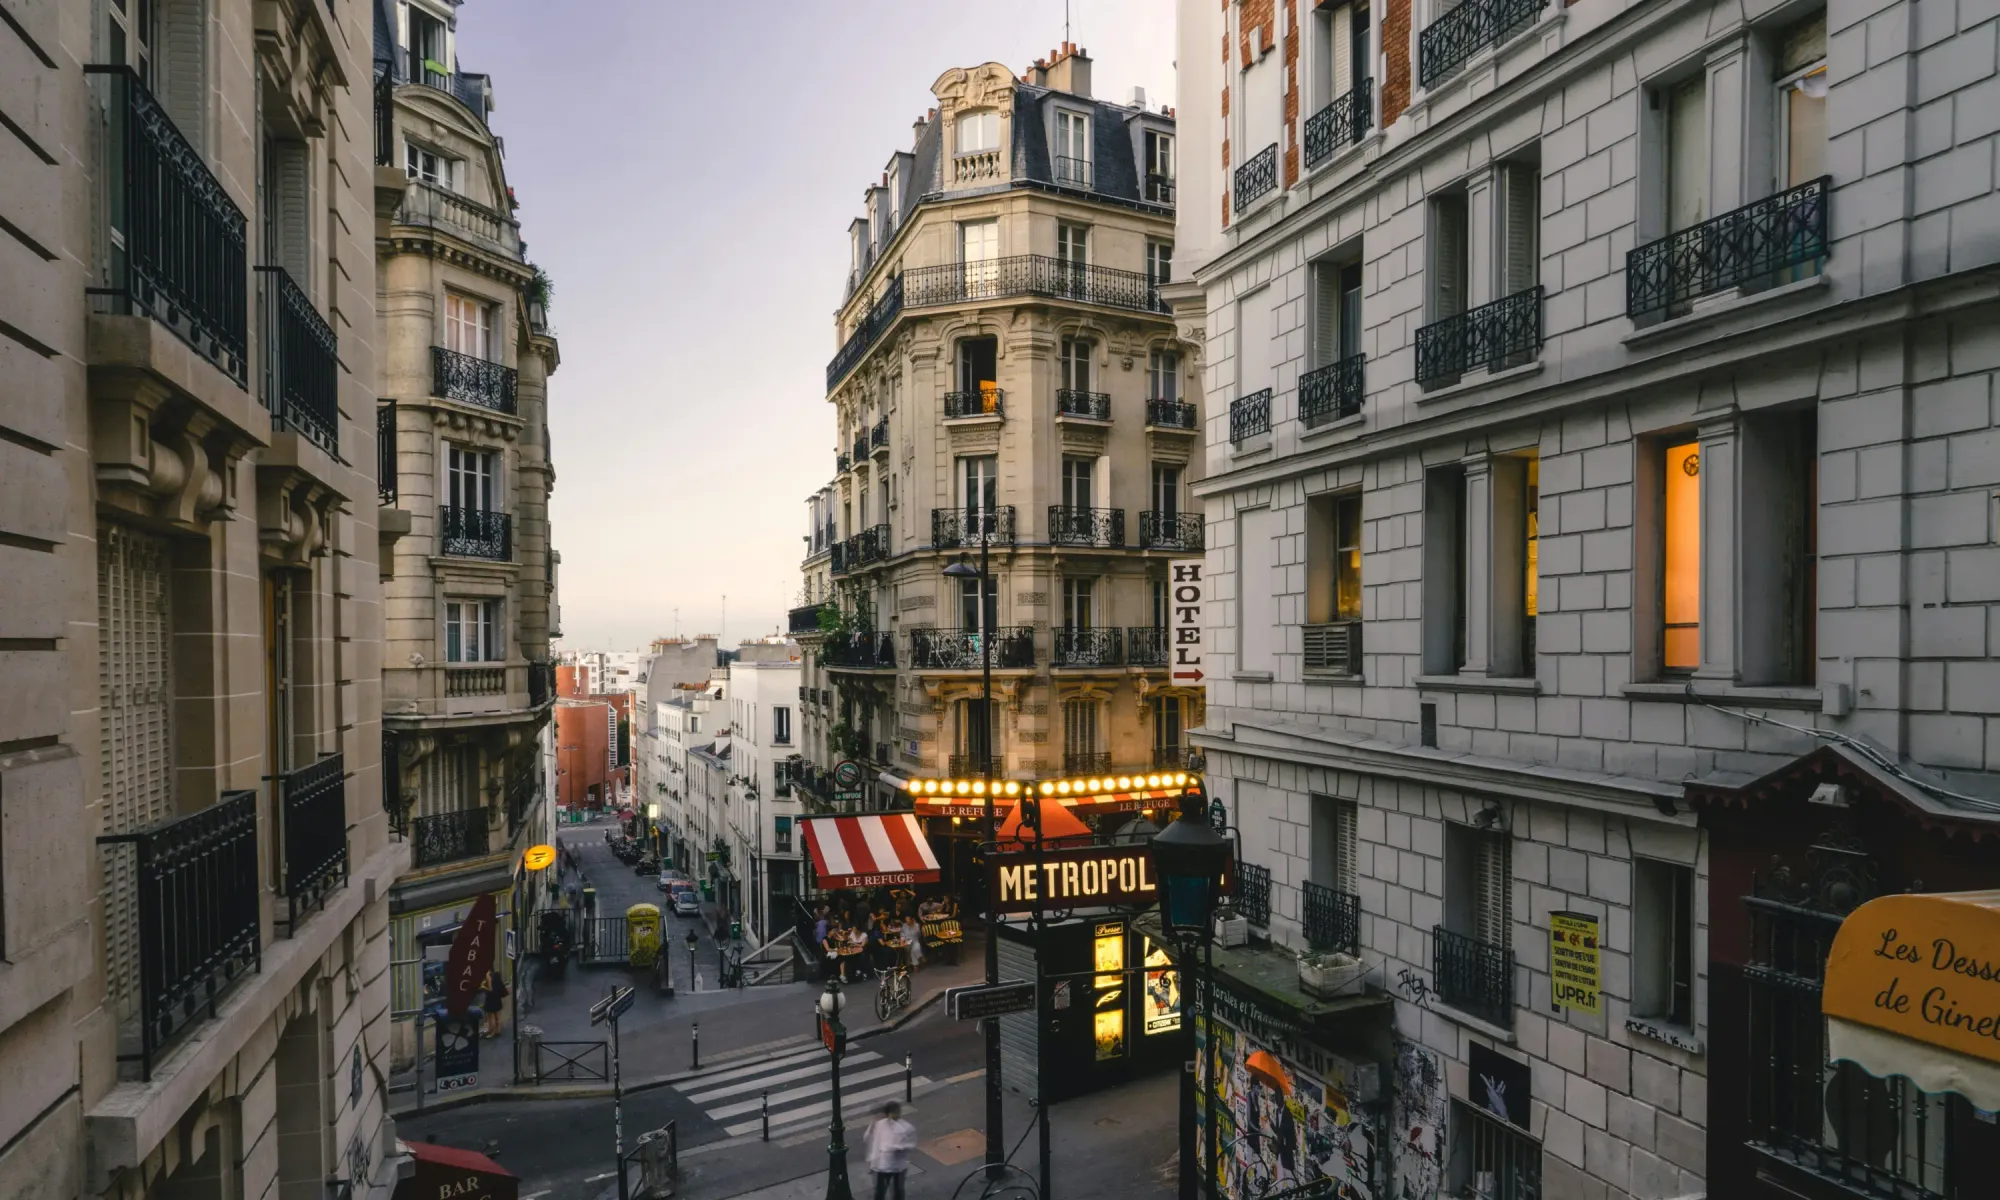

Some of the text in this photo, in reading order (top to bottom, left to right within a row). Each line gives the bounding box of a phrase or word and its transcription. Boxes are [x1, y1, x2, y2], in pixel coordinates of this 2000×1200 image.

[1173, 564, 1202, 665] HOTEL
[941, 806, 1003, 817] LE REFUE
[1120, 802, 1132, 811] LE
[845, 873, 915, 887] LE REFUGE
[1000, 856, 1225, 901] METROPOL
[459, 919, 487, 991] TABAC
[1873, 928, 1922, 963] Les
[1555, 982, 1597, 1008] UPR.fr
[1874, 977, 1911, 1014] de
[440, 1075, 476, 1090] LOTO
[439, 1176, 480, 1200] BAR
